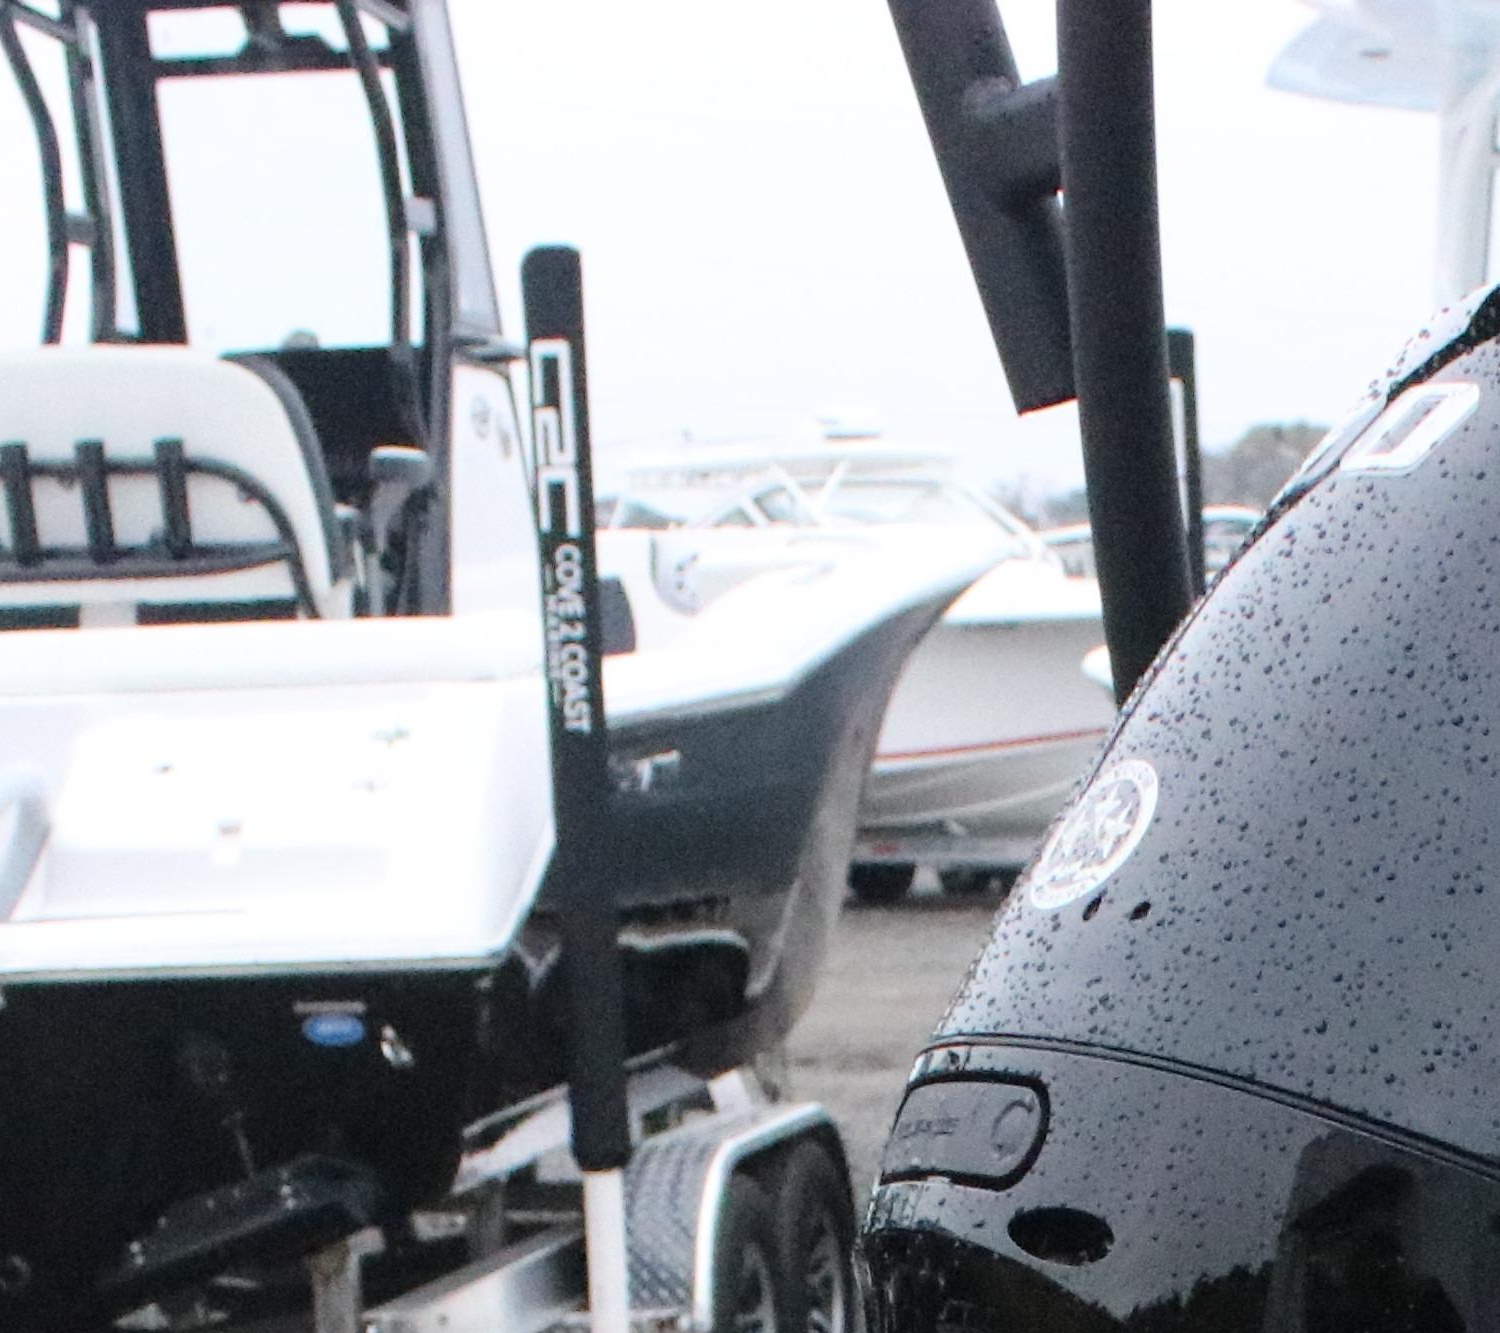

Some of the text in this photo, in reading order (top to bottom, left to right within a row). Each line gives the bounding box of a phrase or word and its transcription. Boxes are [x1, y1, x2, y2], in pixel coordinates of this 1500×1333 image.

[555, 544, 592, 734] COVE 2 COAST
